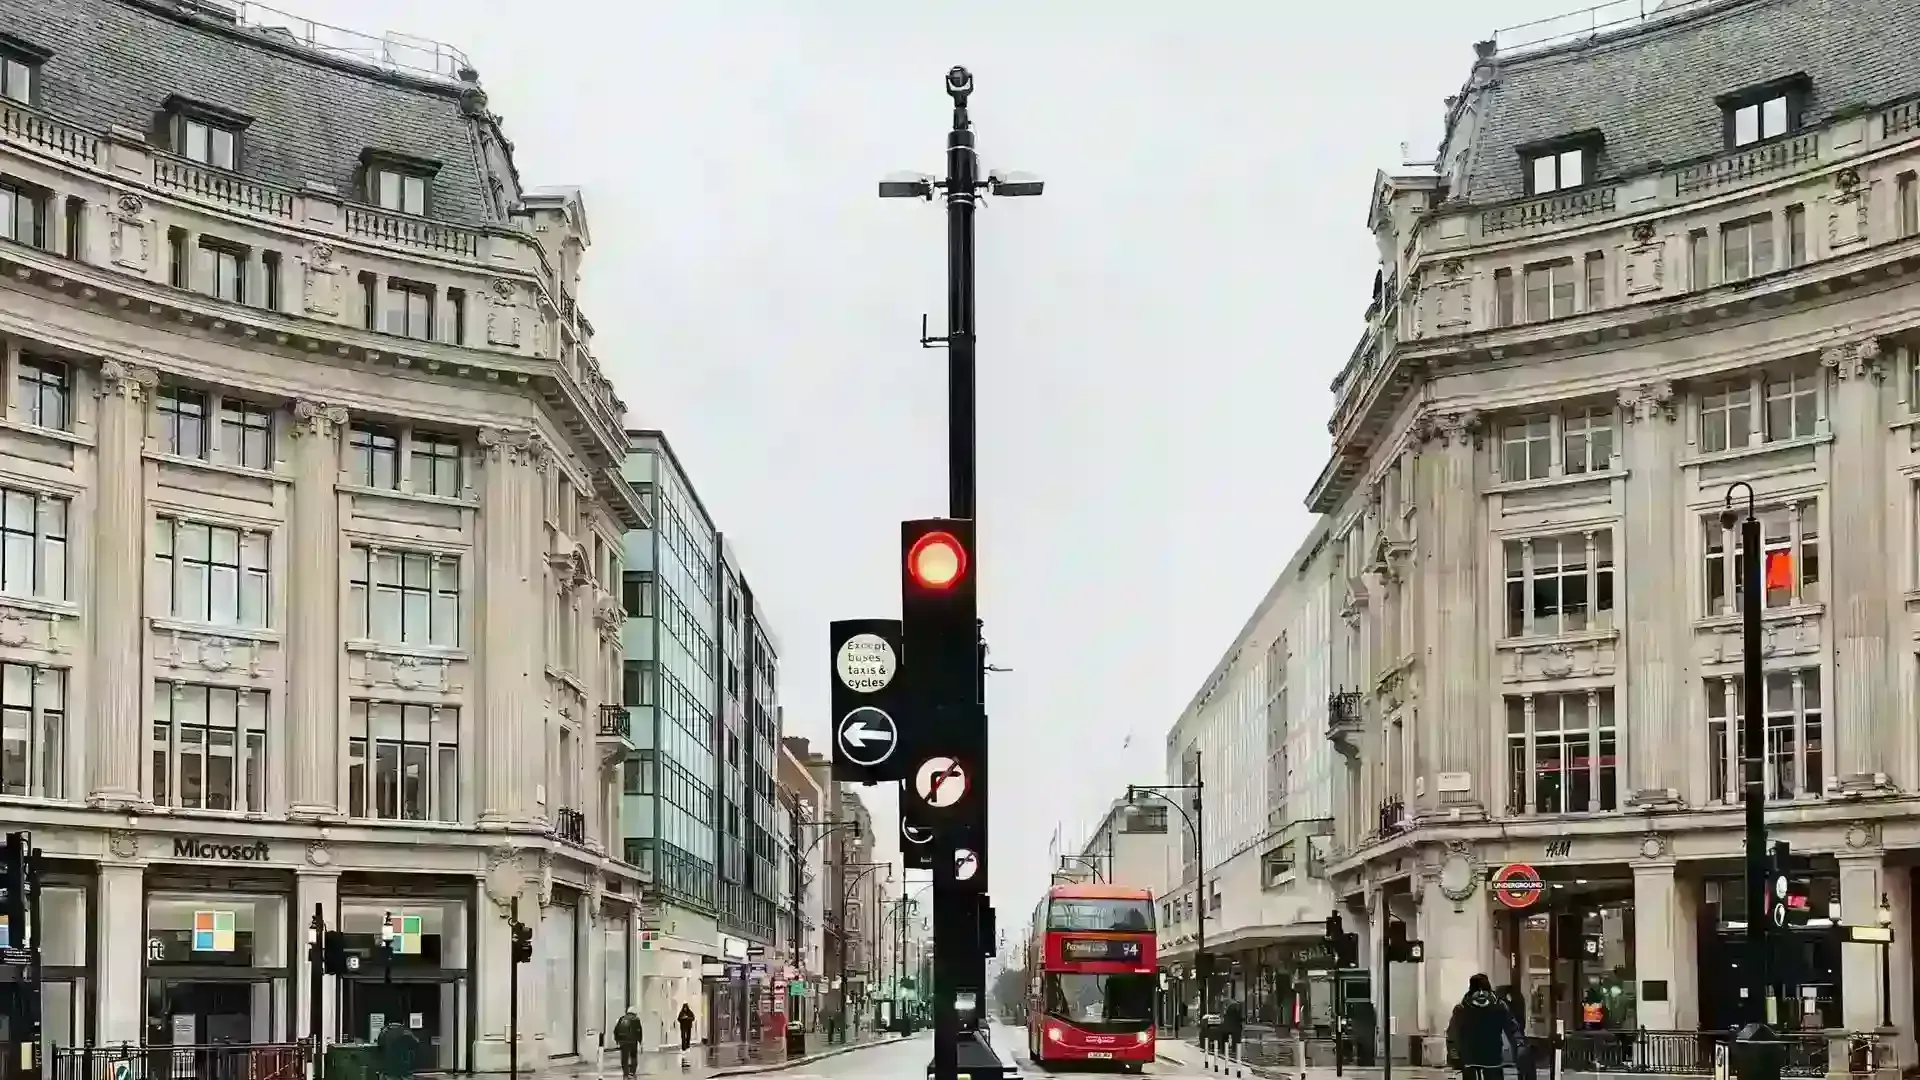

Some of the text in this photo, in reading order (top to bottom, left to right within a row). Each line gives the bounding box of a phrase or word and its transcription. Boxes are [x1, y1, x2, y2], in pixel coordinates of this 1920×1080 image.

[847, 641, 886, 651] Except
[848, 664, 886, 675] taxis &
[848, 677, 885, 688] cycles
[174, 838, 270, 861] Microsoft
[1546, 840, 1571, 857] H&M
[1122, 943, 1139, 956] 94
